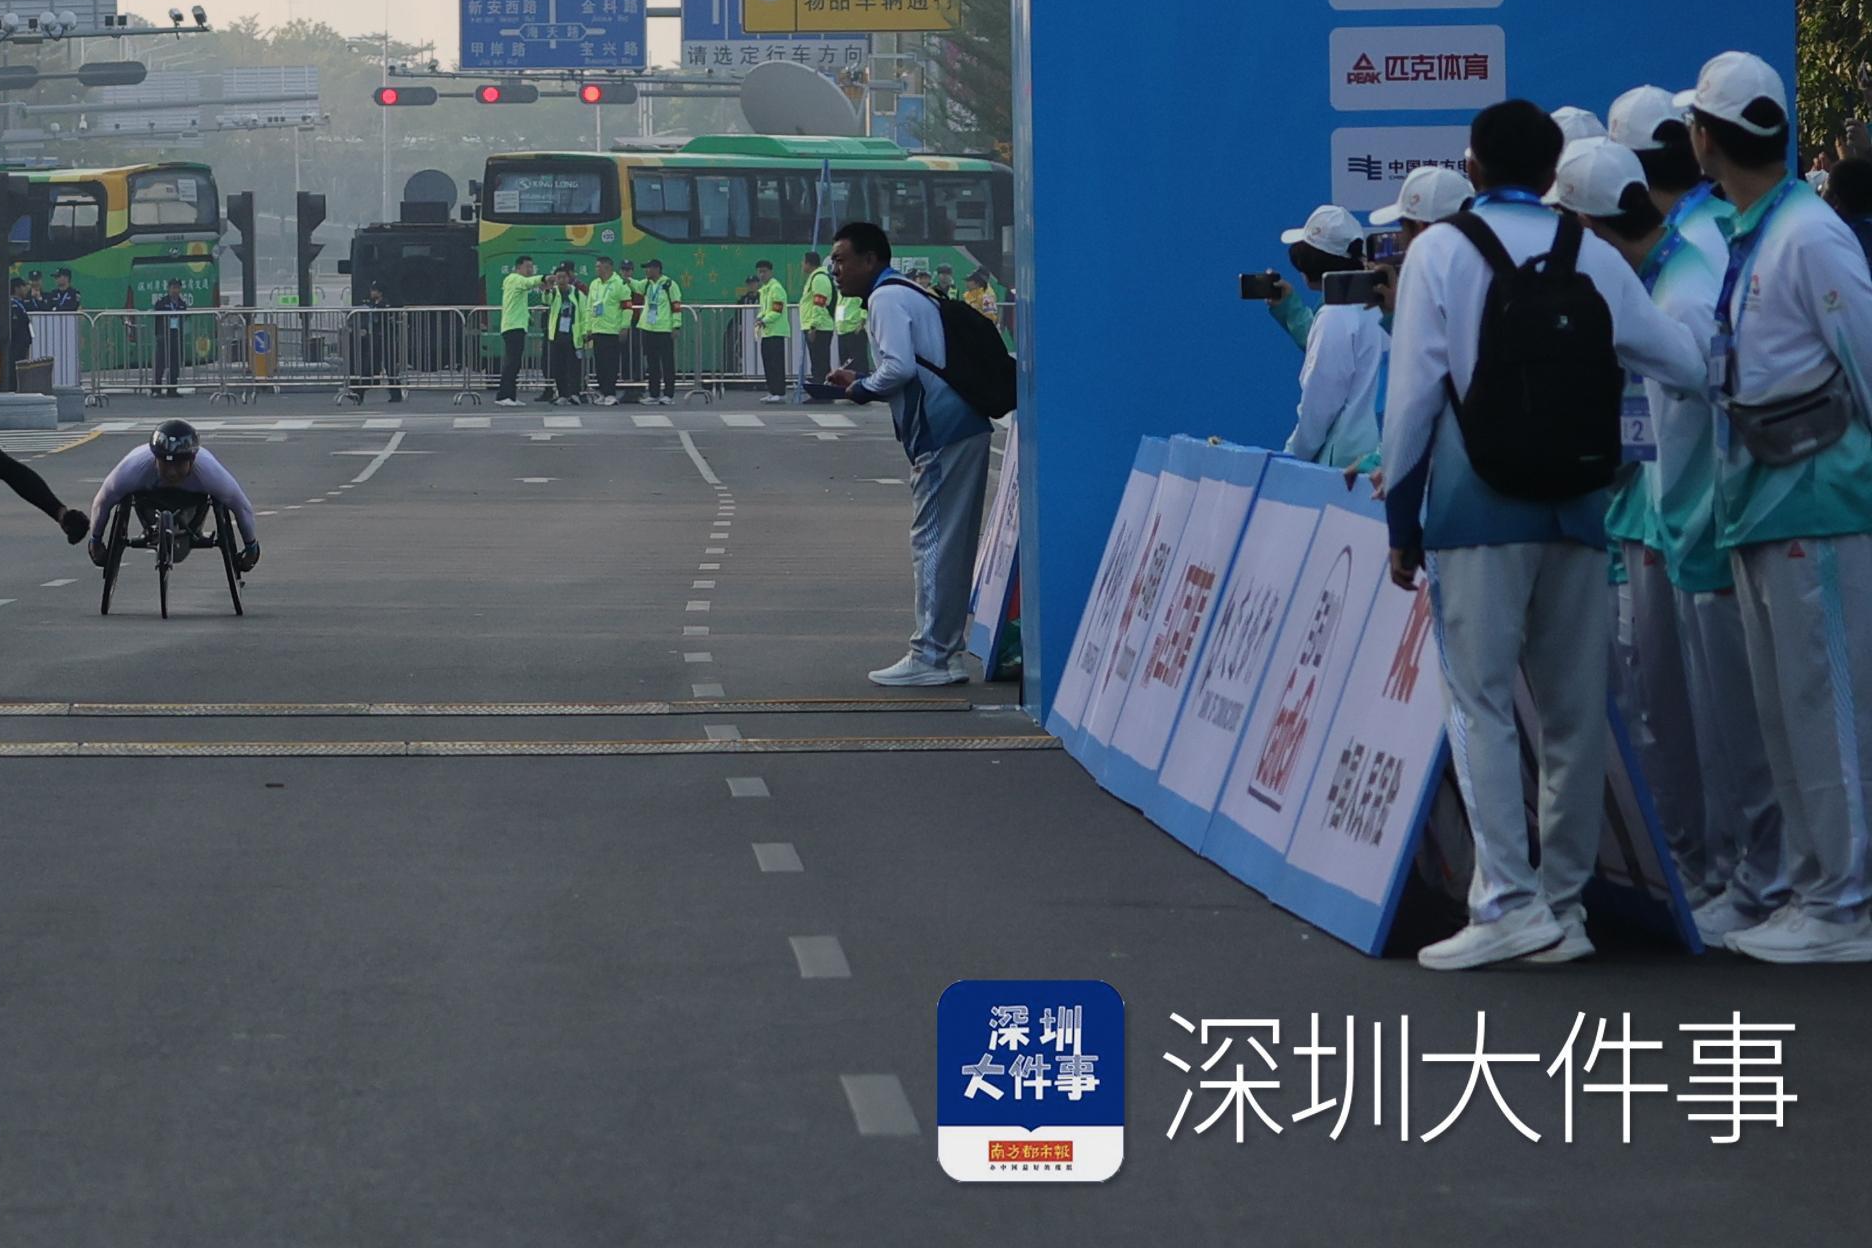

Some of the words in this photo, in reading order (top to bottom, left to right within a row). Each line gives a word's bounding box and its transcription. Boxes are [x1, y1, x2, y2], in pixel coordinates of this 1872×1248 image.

[468, 0, 537, 14] 新安西路
[688, 46, 863, 66] 请选定行车方向
[1385, 54, 1488, 81] 匹克体育
[1347, 73, 1381, 84] PEAK
[1632, 420, 1645, 442] 2
